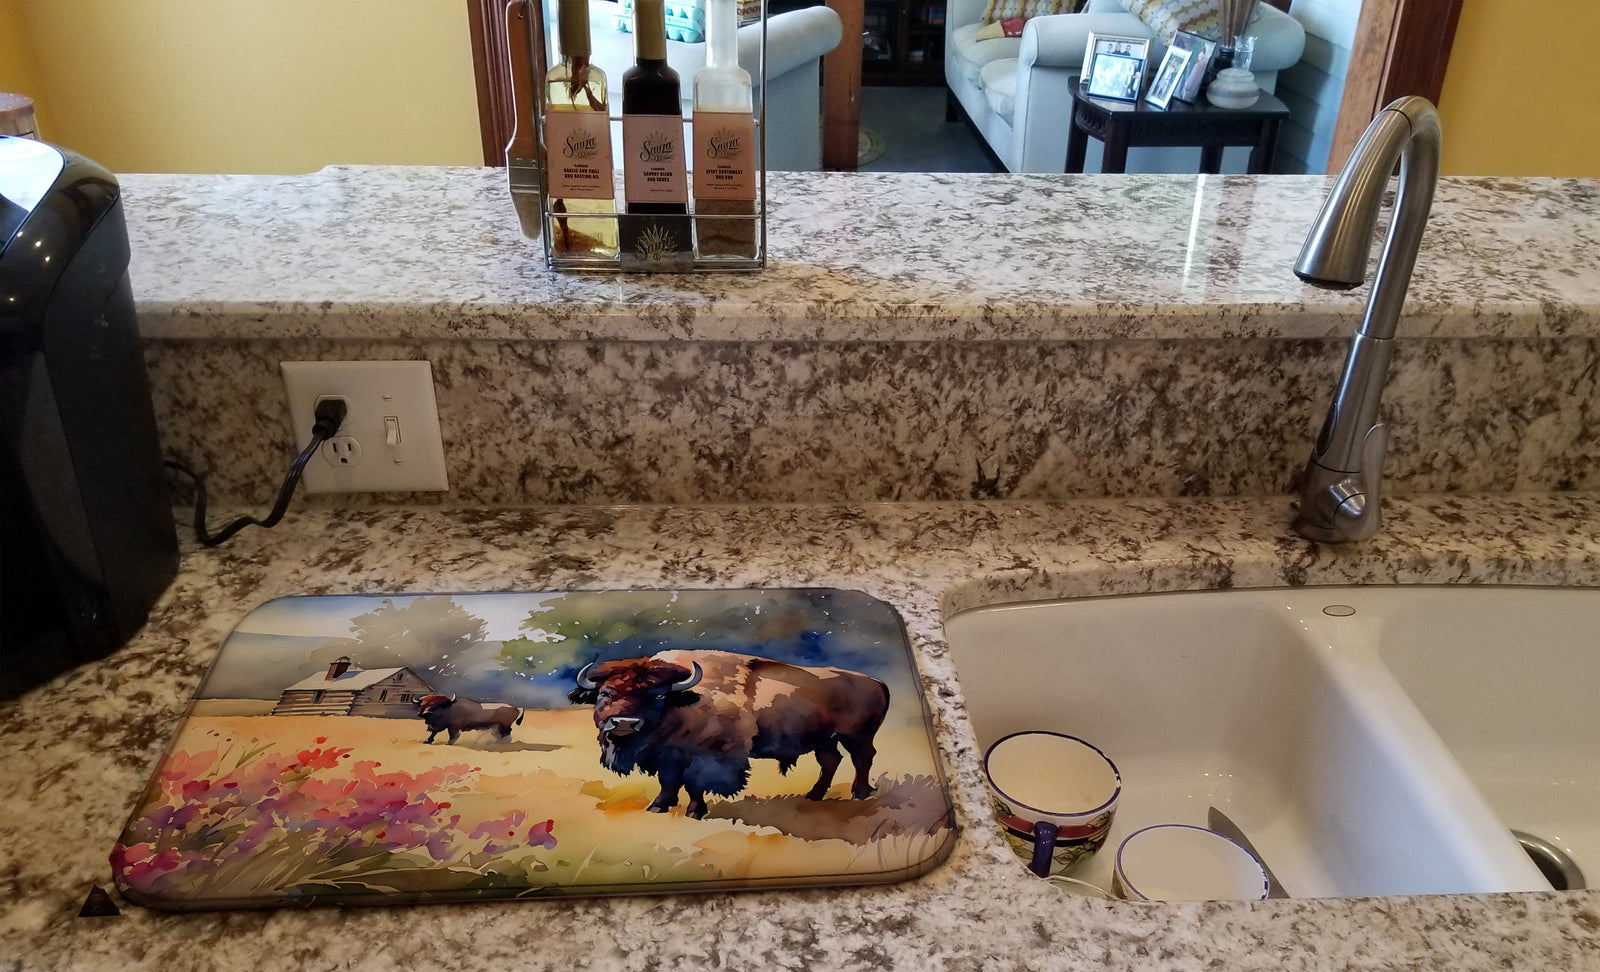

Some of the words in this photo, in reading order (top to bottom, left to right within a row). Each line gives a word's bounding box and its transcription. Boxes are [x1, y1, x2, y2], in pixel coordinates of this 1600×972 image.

[563, 136, 597, 158] Sauza
[640, 140, 673, 162] Sauza
[707, 137, 740, 159] Sauza
